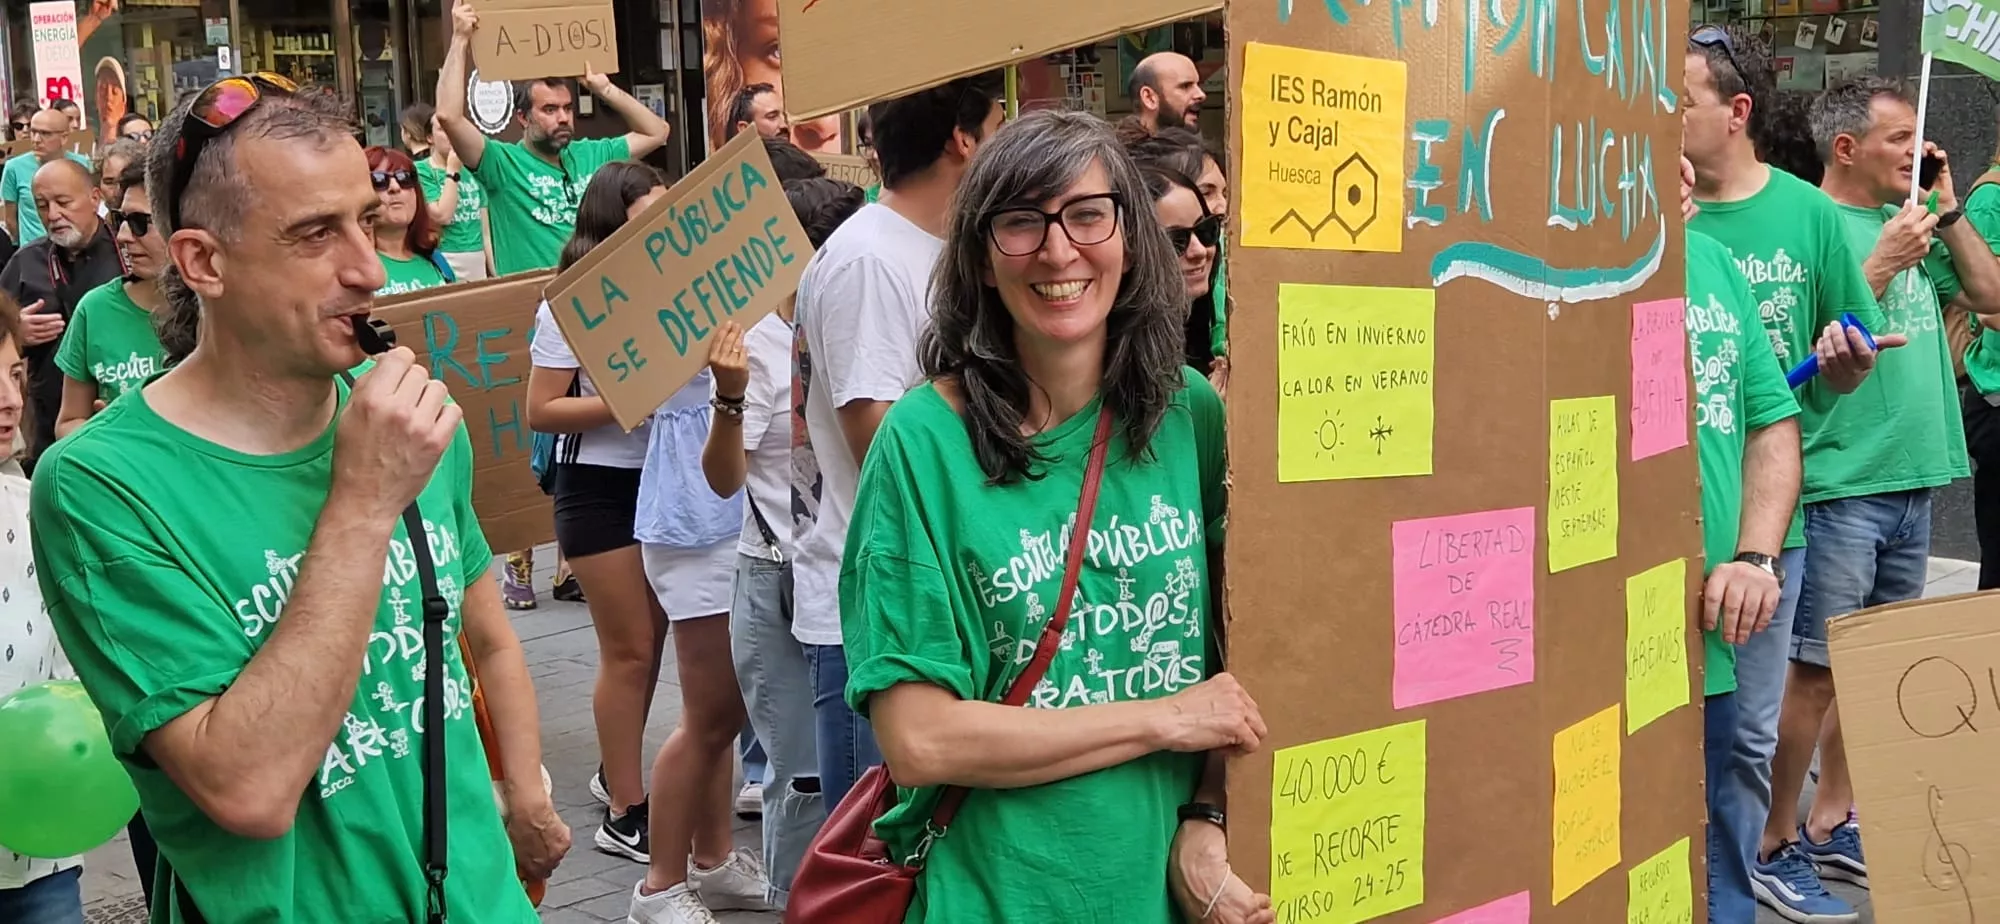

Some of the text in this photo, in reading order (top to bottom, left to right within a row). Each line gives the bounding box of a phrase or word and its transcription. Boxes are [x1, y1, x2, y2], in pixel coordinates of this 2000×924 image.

[33, 12, 74, 25] OPERACIÓN
[34, 25, 76, 42] ENERGÍA
[1271, 73, 1382, 113] IES Ramón
[1269, 116, 1339, 151] y Cajal
[1269, 160, 1321, 185] Huesca
[1407, 107, 1505, 230] EN
[1547, 115, 1660, 242] LUCHA
[571, 160, 767, 331] LA PÚBLICA
[607, 216, 796, 383] SE DEFIENDE
[423, 309, 535, 391] RE
[1283, 317, 1316, 351] FRÍO
[1326, 322, 1347, 345] EN
[1283, 369, 1428, 398] CALOR EN VERANO
[1556, 411, 1581, 438] AULAS
[1555, 448, 1595, 475] ESPAÑOL
[1554, 482, 1582, 510] DESDE
[1419, 525, 1525, 569] LIBERTAD
[1447, 571, 1475, 595] DE
[1642, 587, 1657, 618] NO
[1398, 612, 1476, 646] CÁTEDRA
[1279, 741, 1396, 807] 40.000 €
[1277, 814, 1401, 878] DE RECORTE
